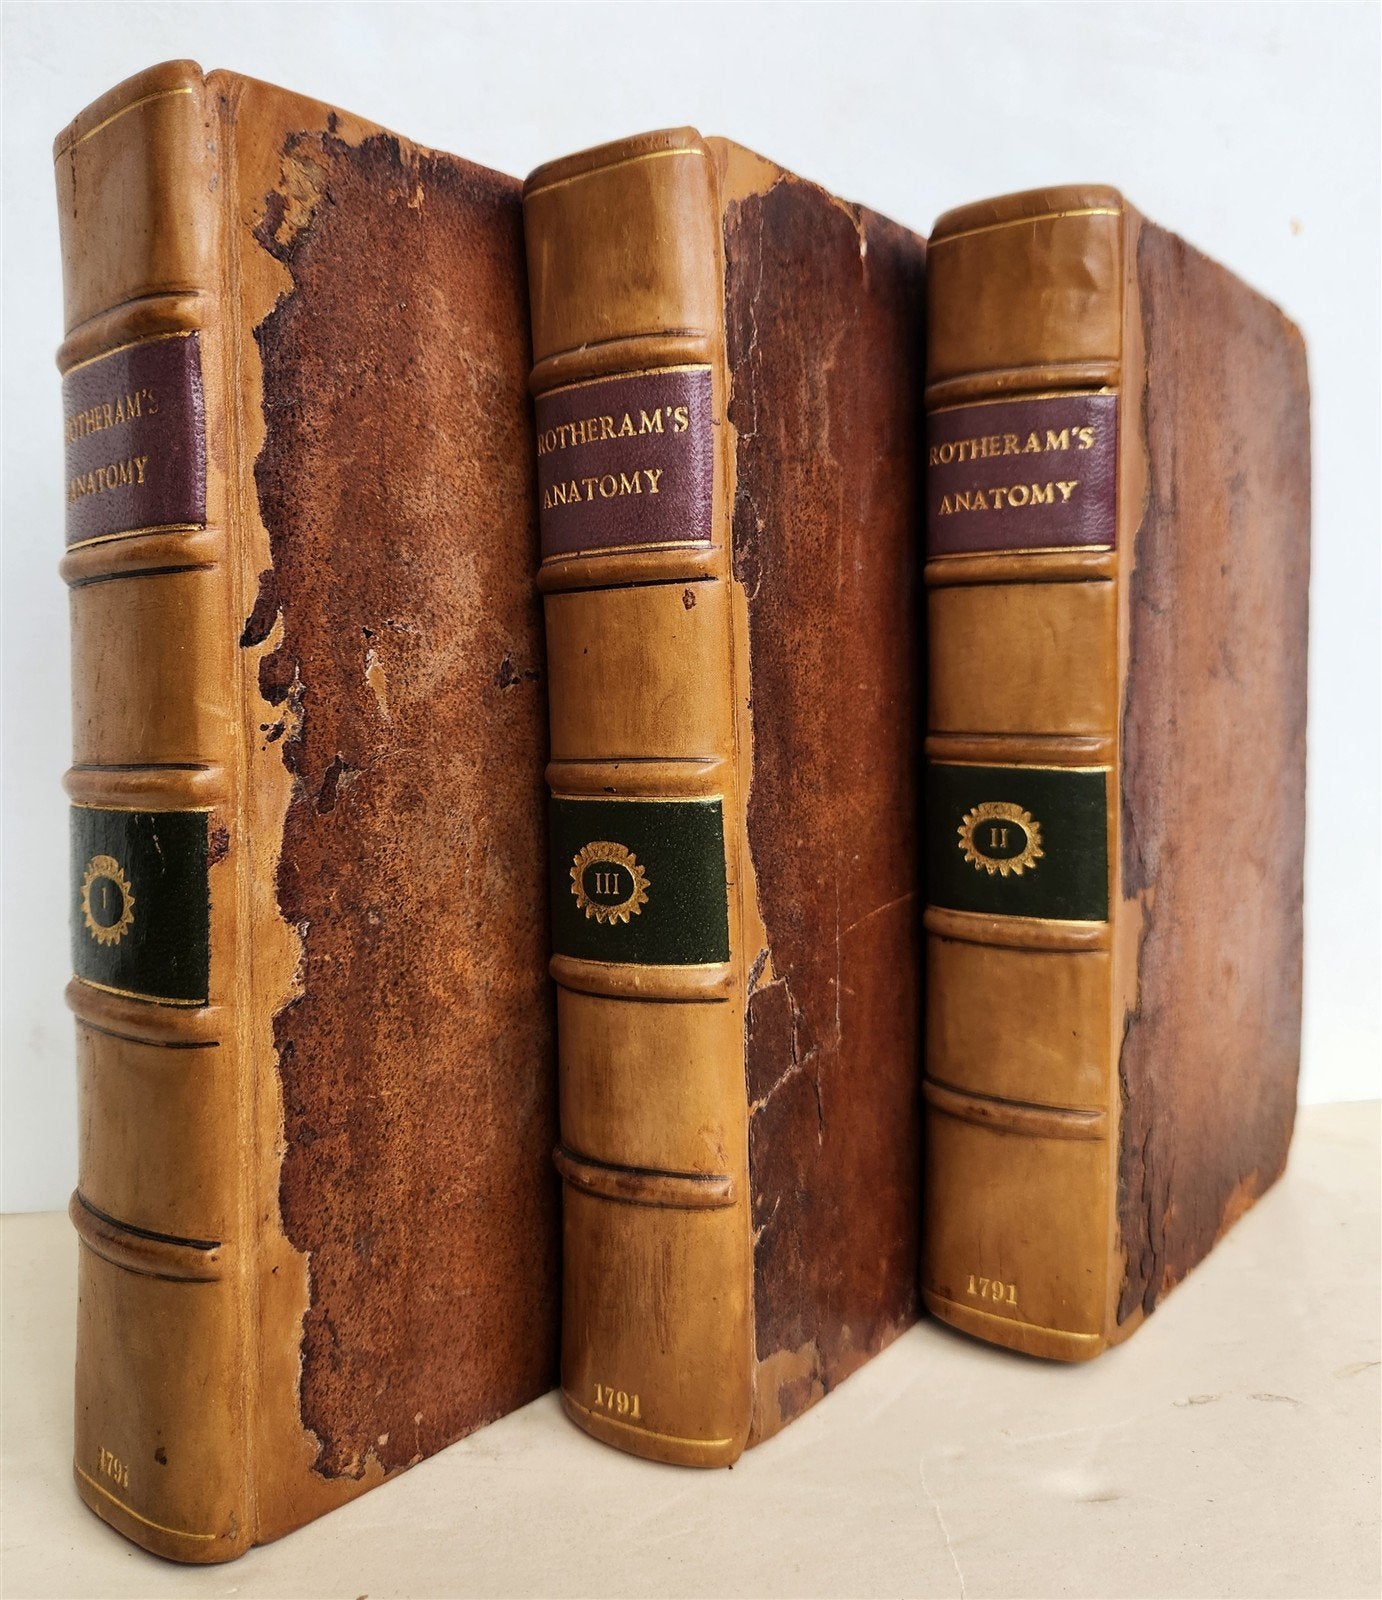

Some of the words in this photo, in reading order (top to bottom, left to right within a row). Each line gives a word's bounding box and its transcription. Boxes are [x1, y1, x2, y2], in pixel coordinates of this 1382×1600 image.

[537, 406, 689, 456] ROTHERAM'S
[928, 426, 1096, 466] ROTHERAM'S
[543, 469, 664, 509] ANATOMY
[938, 479, 1079, 515] ANATOMY
[990, 828, 1008, 848] II
[102, 887, 107, 909] I
[595, 872, 620, 894] III
[966, 1274, 1018, 1305] 1791
[593, 1383, 641, 1418] 1791
[98, 1446, 129, 1489] 1791
